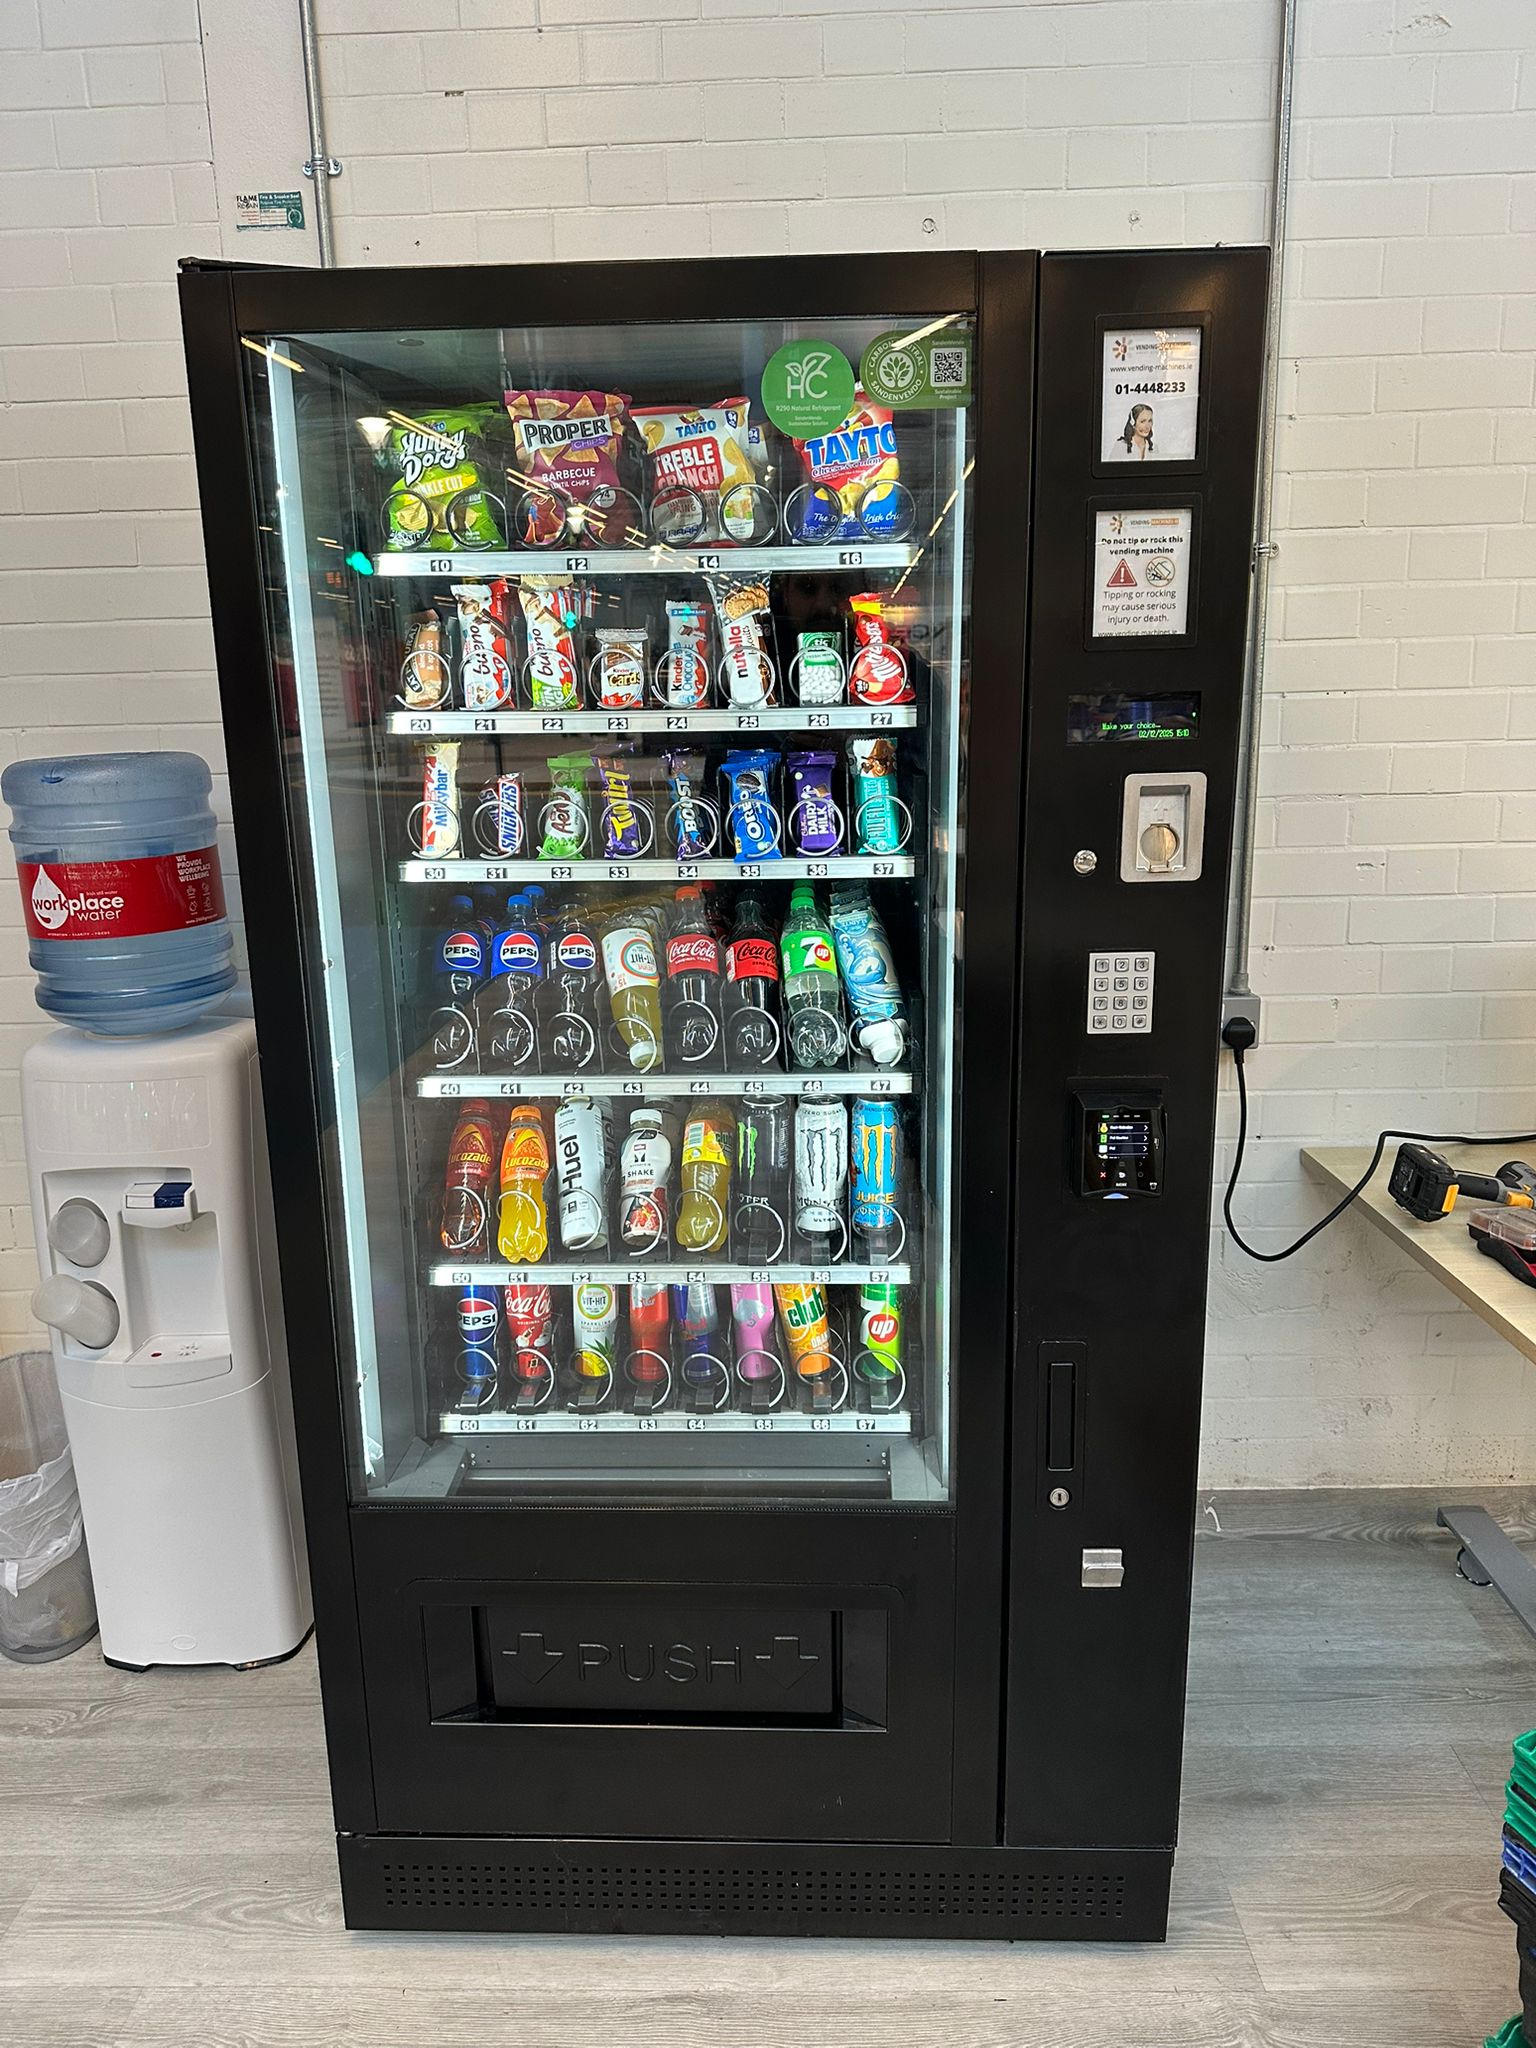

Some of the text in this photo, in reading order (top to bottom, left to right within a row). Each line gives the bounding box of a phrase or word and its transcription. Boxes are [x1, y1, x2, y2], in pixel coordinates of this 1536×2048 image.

[1110, 363, 1193, 373] www.vending-machines.ie
[870, 379, 922, 401] SANDENVENDO
[1115, 382, 1186, 395] 01-4448233
[523, 418, 609, 449] PROPER
[675, 419, 717, 438] TAYTO
[573, 437, 606, 449] CHIPS
[805, 422, 898, 468] TAYTO
[655, 443, 715, 477] TREBLE
[542, 467, 596, 483] BARBECUE
[814, 512, 885, 524] The Irish
[1128, 538, 1139, 546] tip
[1169, 535, 1184, 543] this
[1110, 548, 1140, 556] vending
[569, 558, 587, 570] 12
[701, 556, 719, 568] 14
[842, 553, 861, 564] 16
[433, 560, 450, 572] 10
[1103, 591, 1133, 600] Tipping
[1146, 590, 1177, 599] rocking
[1102, 604, 1119, 612] may
[1107, 615, 1131, 625] injury
[1143, 614, 1169, 622] death.
[470, 625, 490, 675] bueno
[532, 628, 554, 677] bueno
[671, 655, 683, 692] Kinder
[476, 719, 495, 730] 21
[544, 719, 562, 730] 22
[609, 718, 628, 729] 23
[668, 718, 687, 728] 24
[739, 717, 758, 727] 25
[810, 715, 828, 726] 26
[873, 714, 891, 725] 27
[412, 720, 430, 731] 20
[434, 769, 448, 827] Milkybar
[676, 778, 697, 833] BOOST
[501, 783, 518, 851] SNICKERS
[739, 790, 762, 839] OREO
[807, 801, 819, 836] DAIRY
[818, 806, 829, 835] MILK
[177, 858, 202, 869] PROVIDE
[875, 864, 893, 874] 37
[426, 868, 444, 879] 30
[487, 868, 503, 878] 31
[552, 867, 570, 878] 32
[610, 867, 628, 877] 33
[679, 867, 697, 876] 34
[741, 866, 760, 876] 35
[808, 865, 826, 875] 36
[33, 892, 124, 916] workplace
[77, 909, 121, 921] water
[445, 946, 480, 958] PEPSI
[502, 946, 537, 958] PEPSI
[561, 946, 594, 958] PEPSI
[442, 1084, 459, 1094] 40
[501, 1084, 519, 1093] 41
[565, 1083, 582, 1093] 42
[624, 1083, 642, 1093] 43
[691, 1082, 709, 1092] 44
[745, 1082, 763, 1091] 45
[804, 1081, 822, 1091] 46
[871, 1081, 890, 1090] 47
[560, 1135, 582, 1198] Huel
[627, 1169, 654, 1178] SHAKE
[856, 1192, 895, 1204] JUICE
[453, 1273, 470, 1283] 50
[509, 1273, 526, 1282] 51
[573, 1272, 590, 1282] 52
[629, 1272, 645, 1282] 53
[688, 1272, 704, 1282] 54
[753, 1272, 769, 1281] 55
[814, 1272, 830, 1281] 56
[872, 1271, 888, 1281] 57
[788, 1287, 826, 1327] club
[457, 1313, 496, 1326] PEPSI
[870, 1320, 894, 1339] up
[461, 1421, 478, 1430] 60
[518, 1421, 534, 1430] 61
[580, 1420, 597, 1429] 62
[640, 1420, 656, 1429] 63
[688, 1420, 704, 1429] 64
[756, 1420, 772, 1429] 65
[813, 1420, 829, 1429] 66
[858, 1420, 874, 1429] 67
[579, 1642, 742, 1683] PUSH
